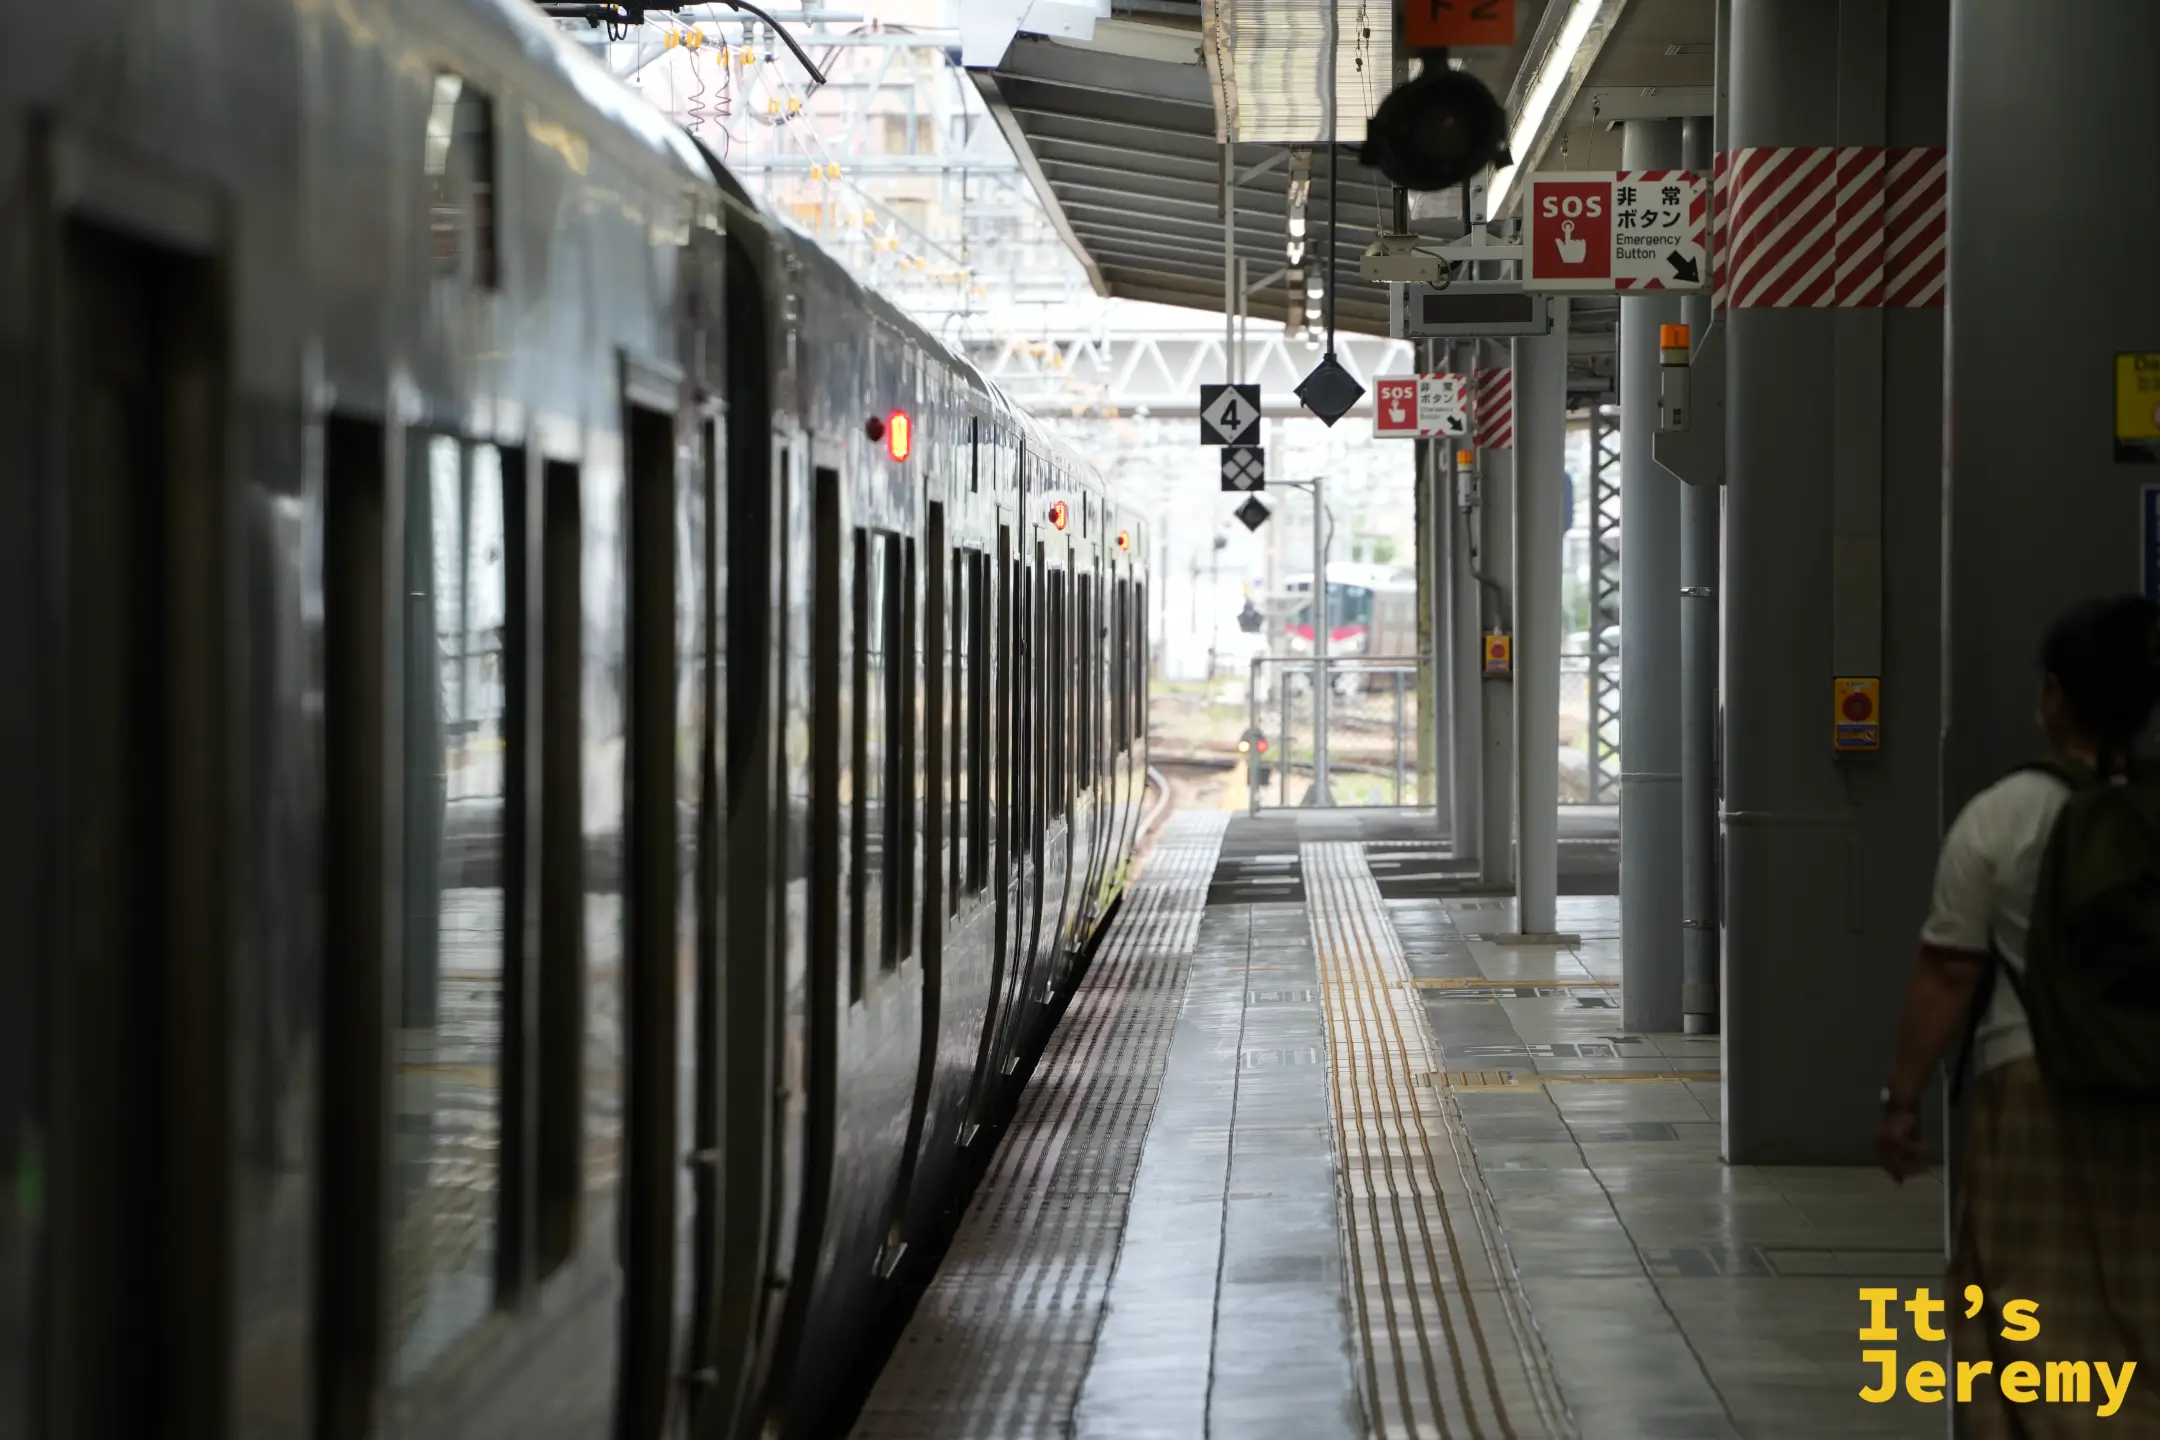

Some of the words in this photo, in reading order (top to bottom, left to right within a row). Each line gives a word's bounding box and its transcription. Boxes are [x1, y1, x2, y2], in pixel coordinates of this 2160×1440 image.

[1617, 186, 1681, 206] 非常
[1542, 195, 1602, 218] SOS
[1617, 210, 1681, 229] ボタン
[1616, 234, 1682, 246] Emergency
[1616, 248, 1656, 259] Button
[1382, 386, 1413, 398] SOS
[1420, 394, 1453, 404] ボタン
[1220, 399, 1241, 430] 4
